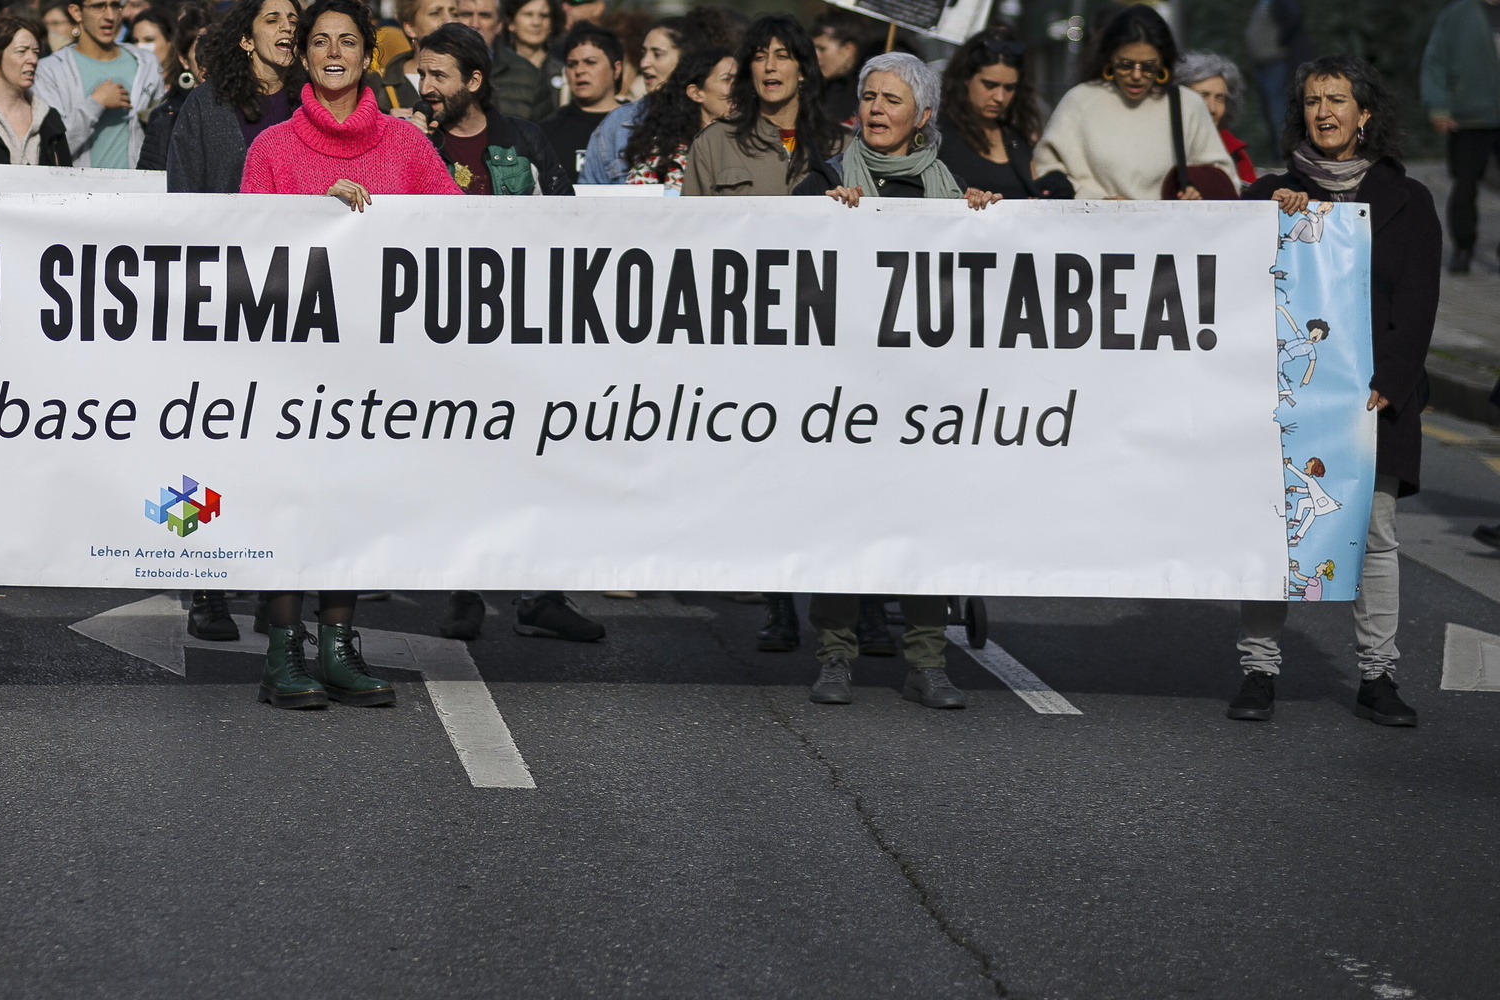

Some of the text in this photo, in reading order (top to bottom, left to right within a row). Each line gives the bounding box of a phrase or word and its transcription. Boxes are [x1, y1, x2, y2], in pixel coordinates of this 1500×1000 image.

[40, 244, 339, 342] SISTEMA
[380, 248, 837, 346] PUBLIKOAREN
[877, 251, 1217, 350] ZUTABEA!
[160, 382, 257, 439] del
[276, 385, 514, 440] sistema
[536, 384, 776, 456] público
[802, 386, 877, 444] de
[900, 388, 1076, 446] salud
[90, 545, 274, 559] Lehen Arreta Arnasberritzen
[135, 567, 228, 579] Eztabaida-Lekua
